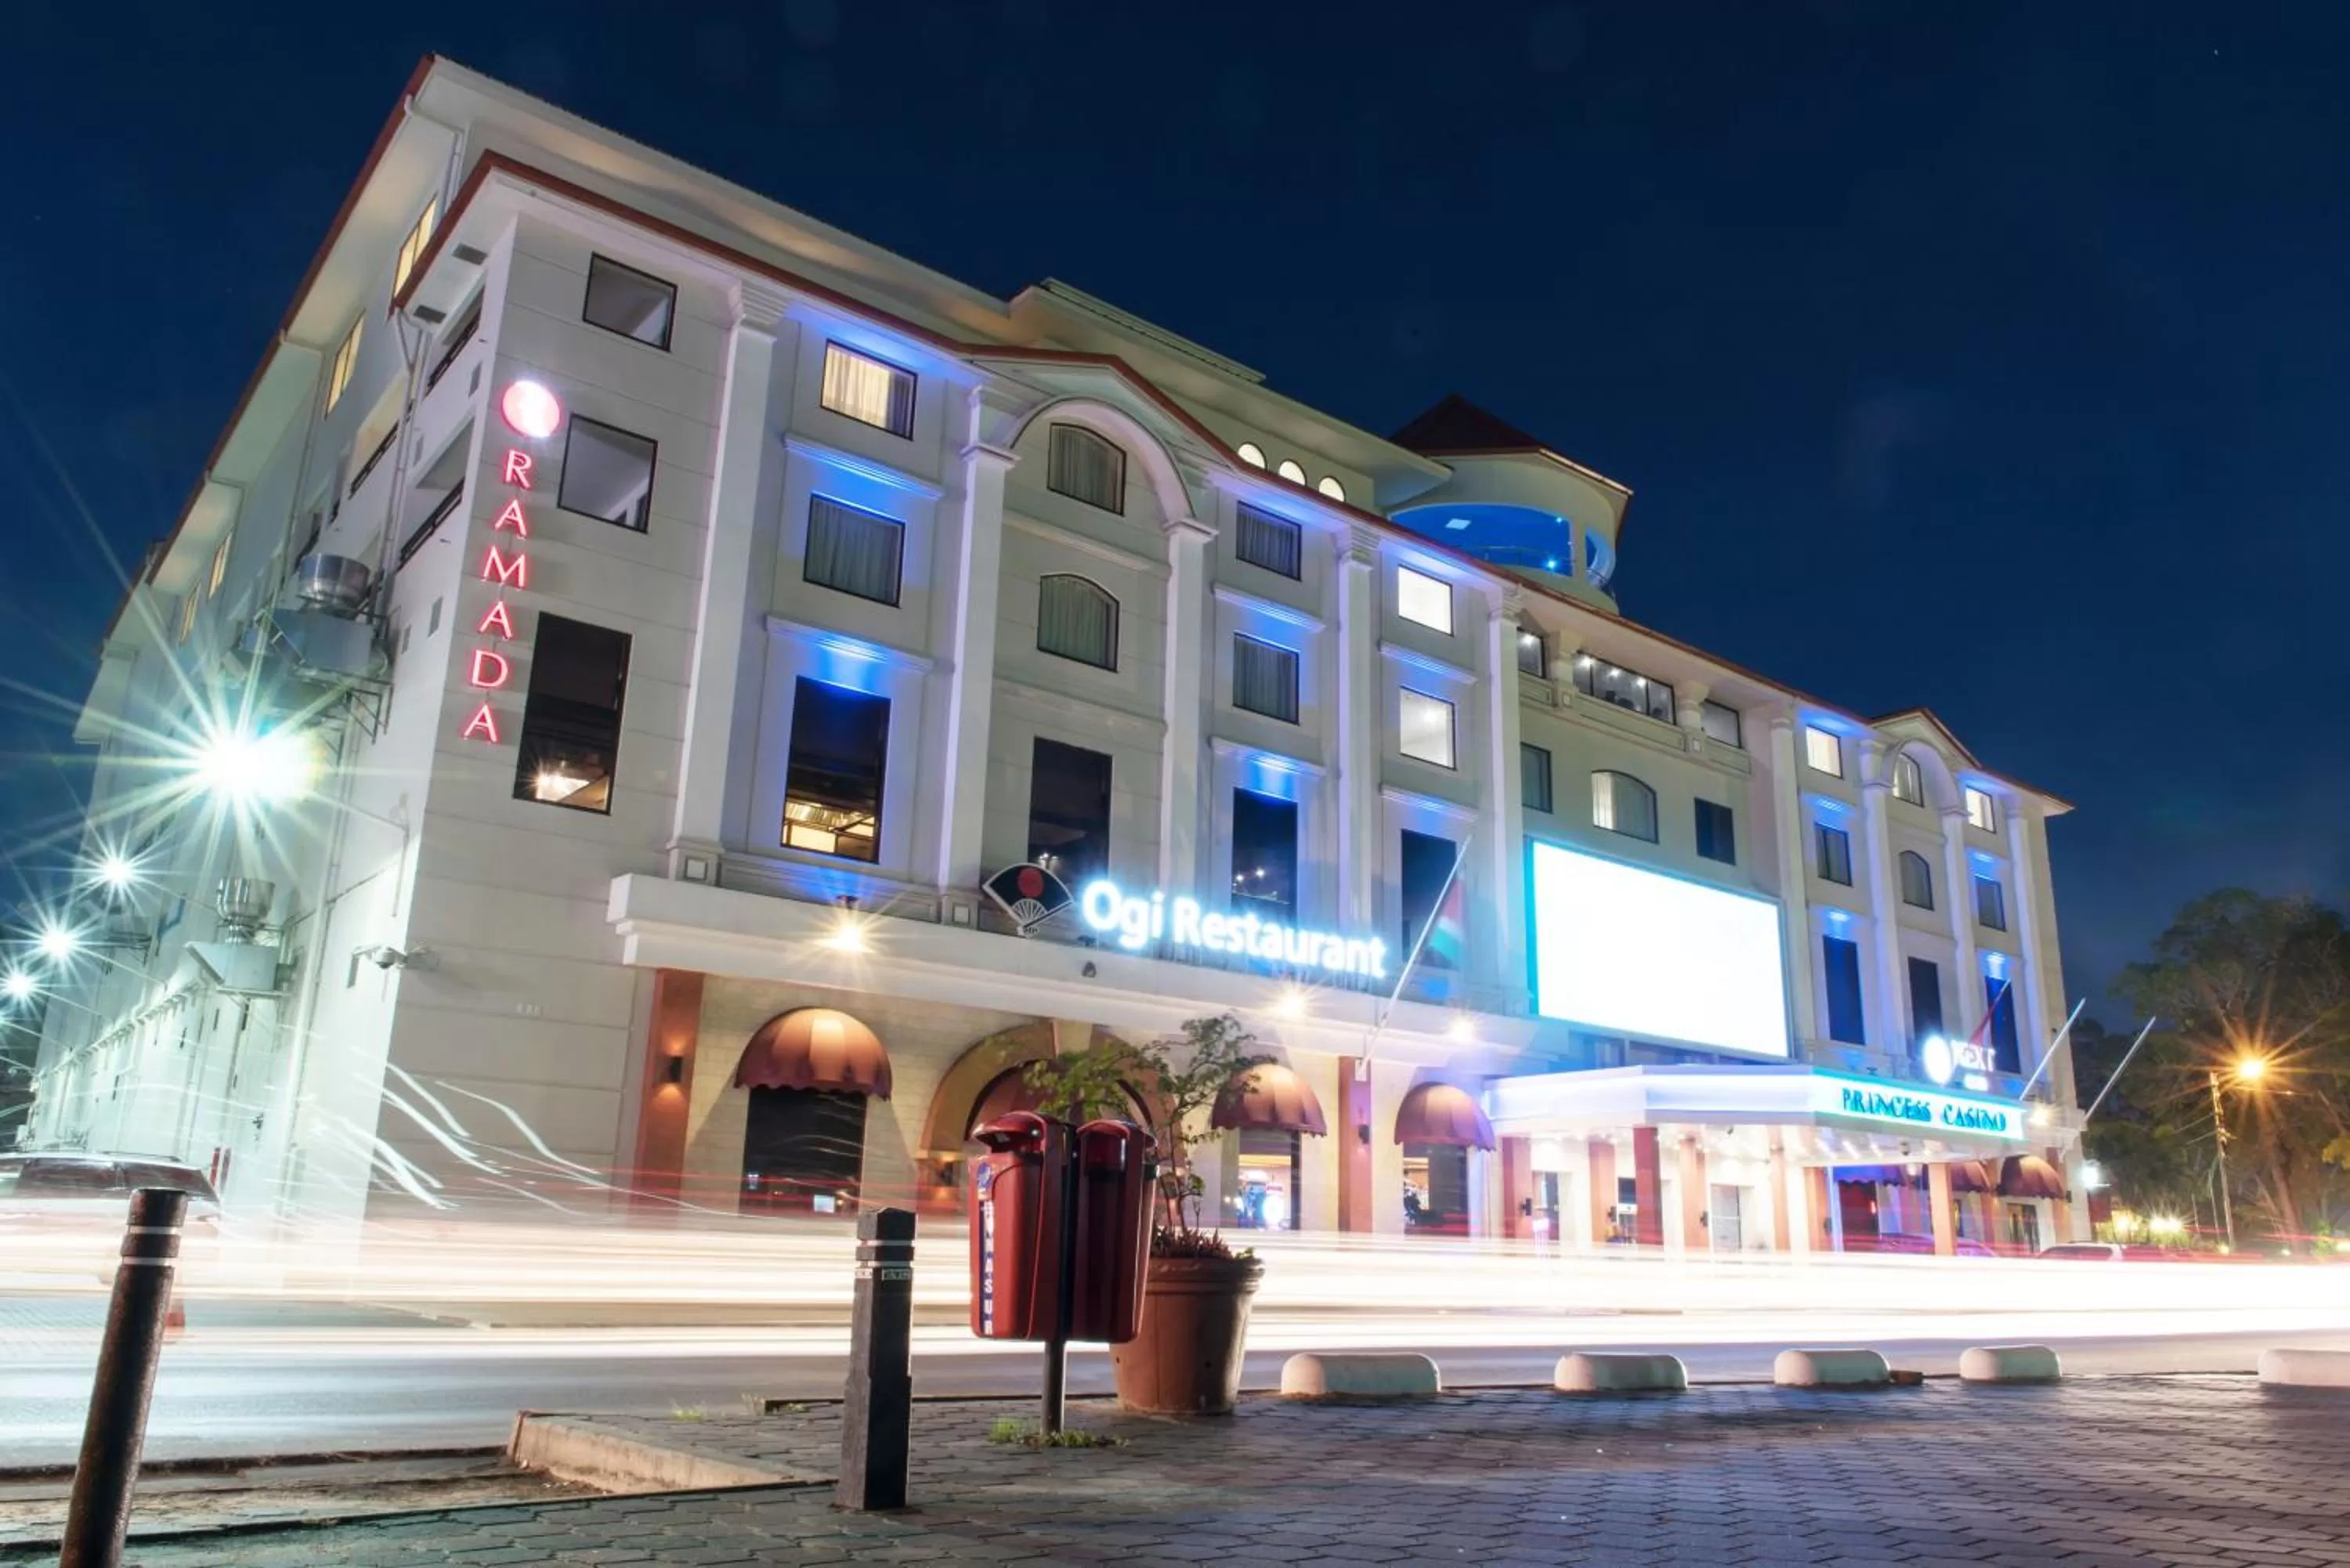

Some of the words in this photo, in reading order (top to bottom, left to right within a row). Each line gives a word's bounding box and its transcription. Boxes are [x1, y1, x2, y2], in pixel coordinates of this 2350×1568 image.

[464, 449, 532, 743] RAMADA
[1083, 880, 1166, 948] Ogi
[1174, 898, 1386, 978] Restaurant
[1842, 1086, 1932, 1122] PRINCESS
[1943, 1103, 2007, 1132] CASINO
